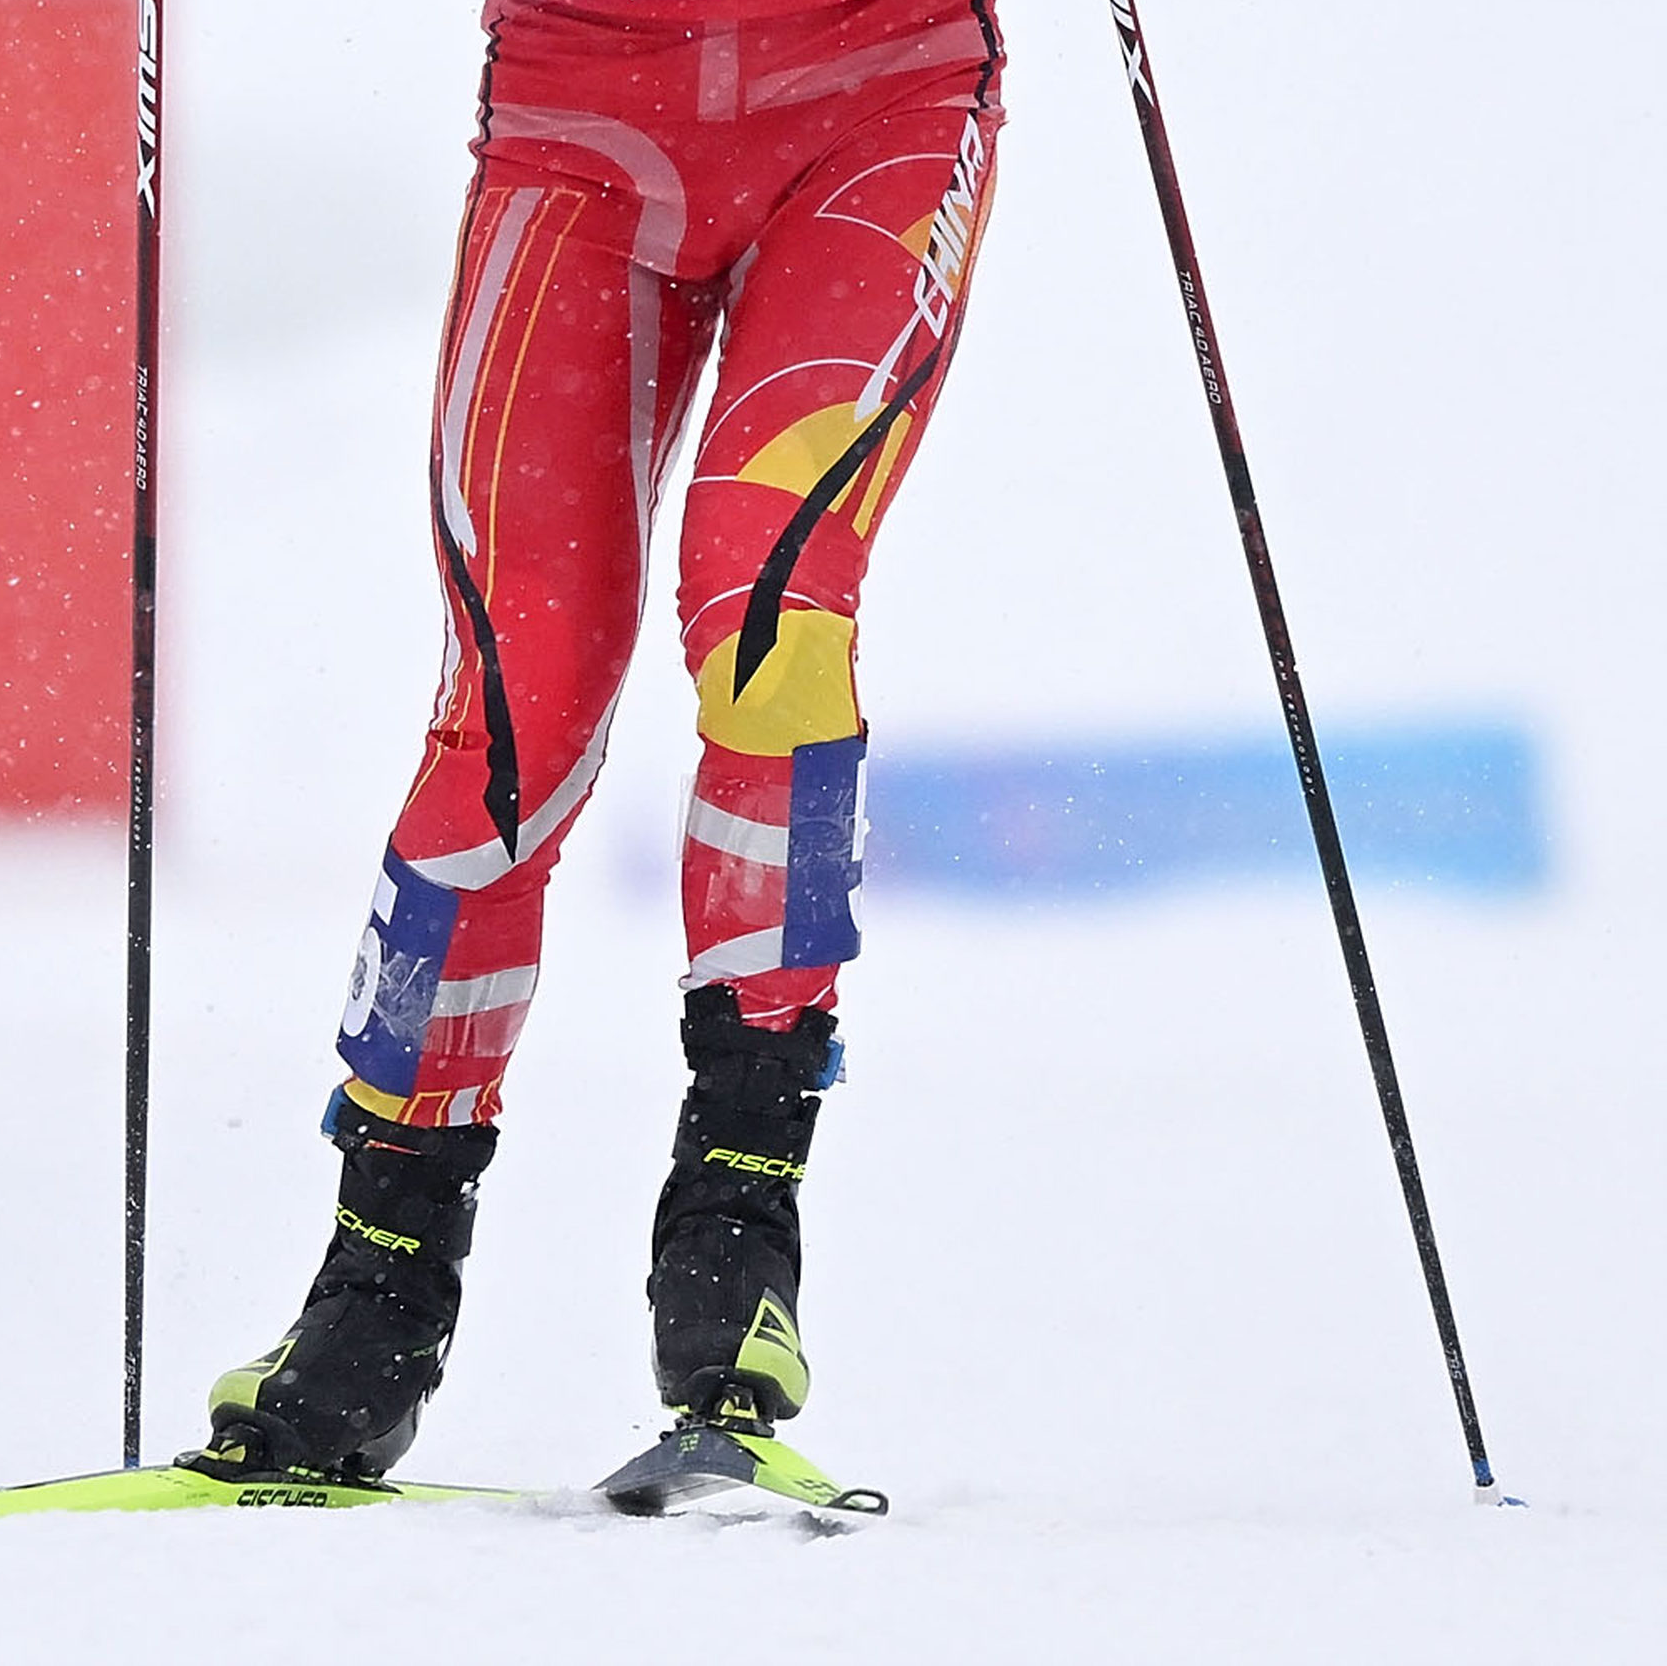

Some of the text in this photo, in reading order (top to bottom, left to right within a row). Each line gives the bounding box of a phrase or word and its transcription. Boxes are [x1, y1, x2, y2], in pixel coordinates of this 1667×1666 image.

[913, 113, 985, 340] CHINA
[1179, 270, 1202, 325] TRIAC
[1199, 352, 1223, 405] AERO
[136, 365, 148, 416] TRIAC
[136, 441, 147, 491] AERO
[336, 1202, 421, 1255] CHER
